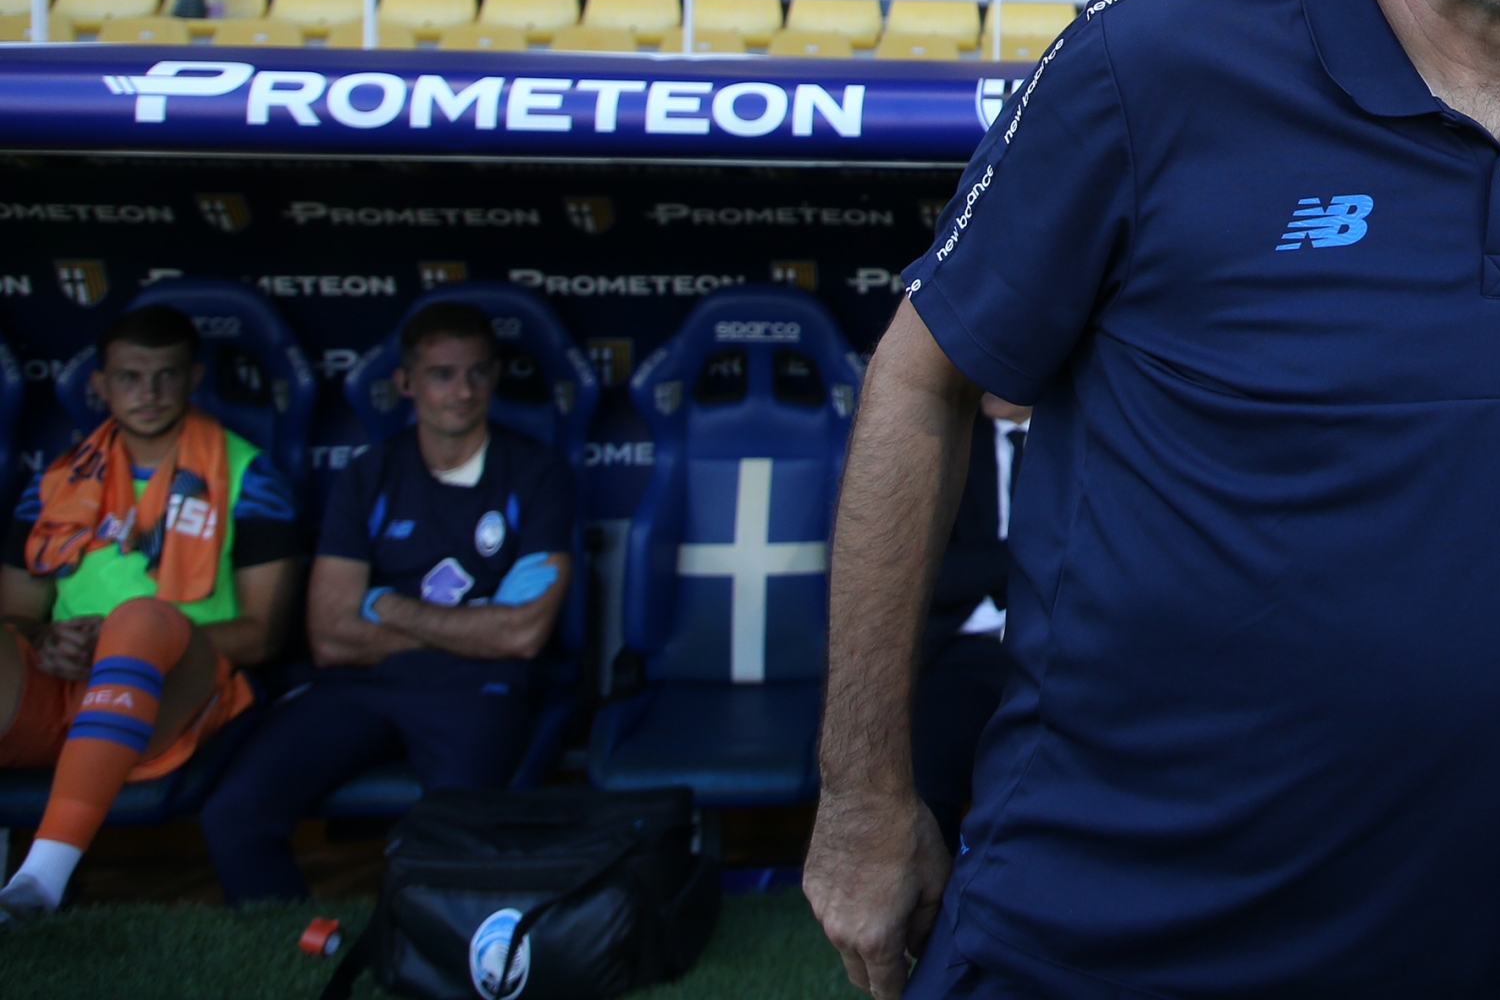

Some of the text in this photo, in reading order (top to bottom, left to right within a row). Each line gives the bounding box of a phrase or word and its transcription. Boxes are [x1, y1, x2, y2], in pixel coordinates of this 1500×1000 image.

[103, 60, 866, 138] PROMETEON
[1003, 38, 1064, 145] new balance
[281, 200, 543, 227] PROMETEON
[643, 201, 895, 227] PROMETEON
[1275, 194, 1374, 251] NB
[936, 226, 960, 262] new
[714, 320, 801, 341] sparco
